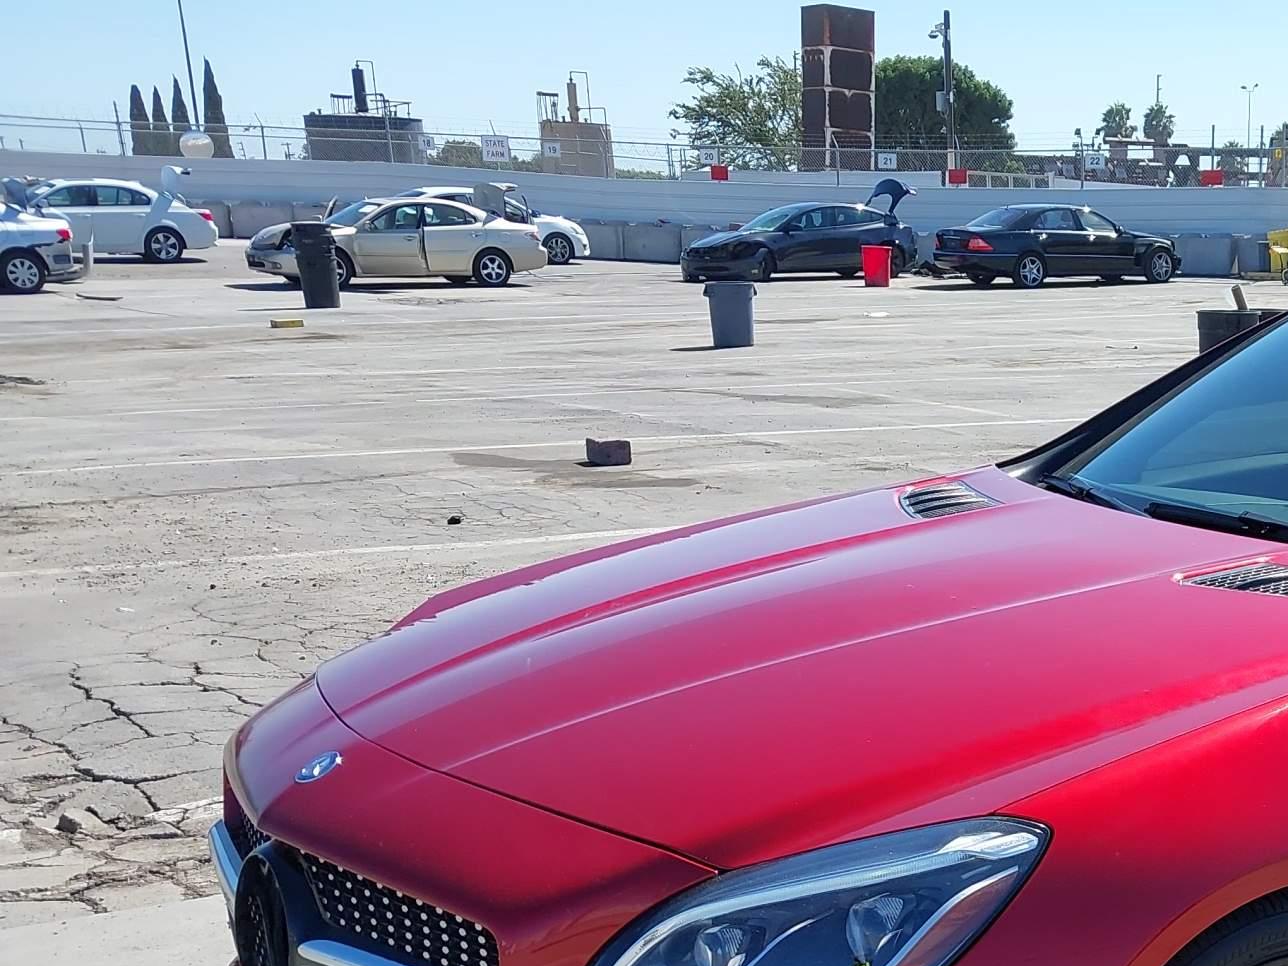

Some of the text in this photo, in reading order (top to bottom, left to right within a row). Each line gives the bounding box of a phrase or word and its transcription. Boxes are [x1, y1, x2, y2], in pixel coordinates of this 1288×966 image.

[422, 139, 431, 147] 18
[485, 139, 505, 148] STATE
[486, 150, 505, 158] FARM
[548, 146, 557, 154] 19
[704, 152, 714, 161] 20
[1090, 156, 1100, 165] 22
[883, 157, 892, 165] 21
